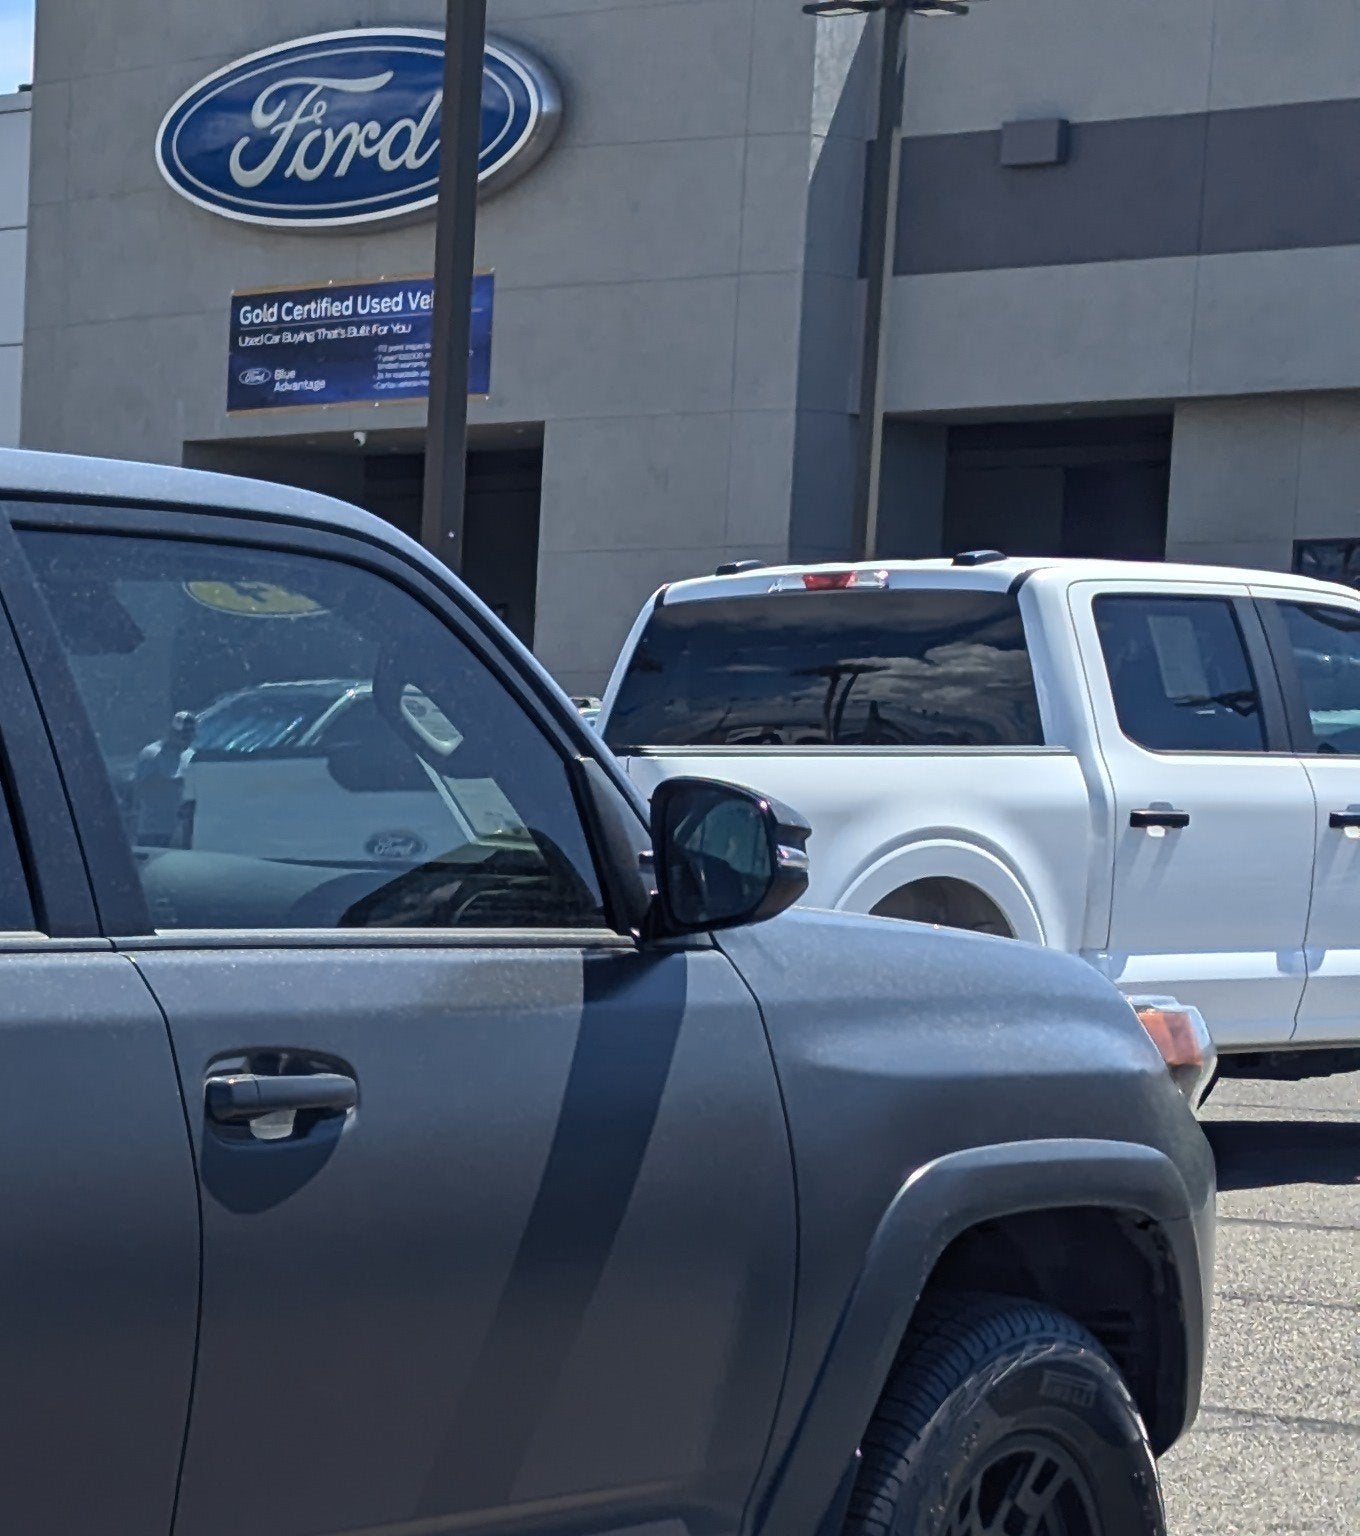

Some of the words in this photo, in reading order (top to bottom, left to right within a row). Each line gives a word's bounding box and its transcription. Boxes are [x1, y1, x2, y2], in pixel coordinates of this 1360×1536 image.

[229, 70, 443, 188] Ford
[239, 302, 279, 325] Gold
[281, 296, 353, 321] Certified
[357, 292, 403, 316] Used
[238, 333, 264, 347] Used
[264, 333, 281, 345] Car
[281, 329, 316, 344] Buying
[316, 327, 346, 340] That's
[347, 325, 370, 338] Built
[371, 324, 390, 336] For
[392, 322, 412, 334] You
[273, 378, 326, 392] Advantage
[274, 368, 296, 380] Blue
